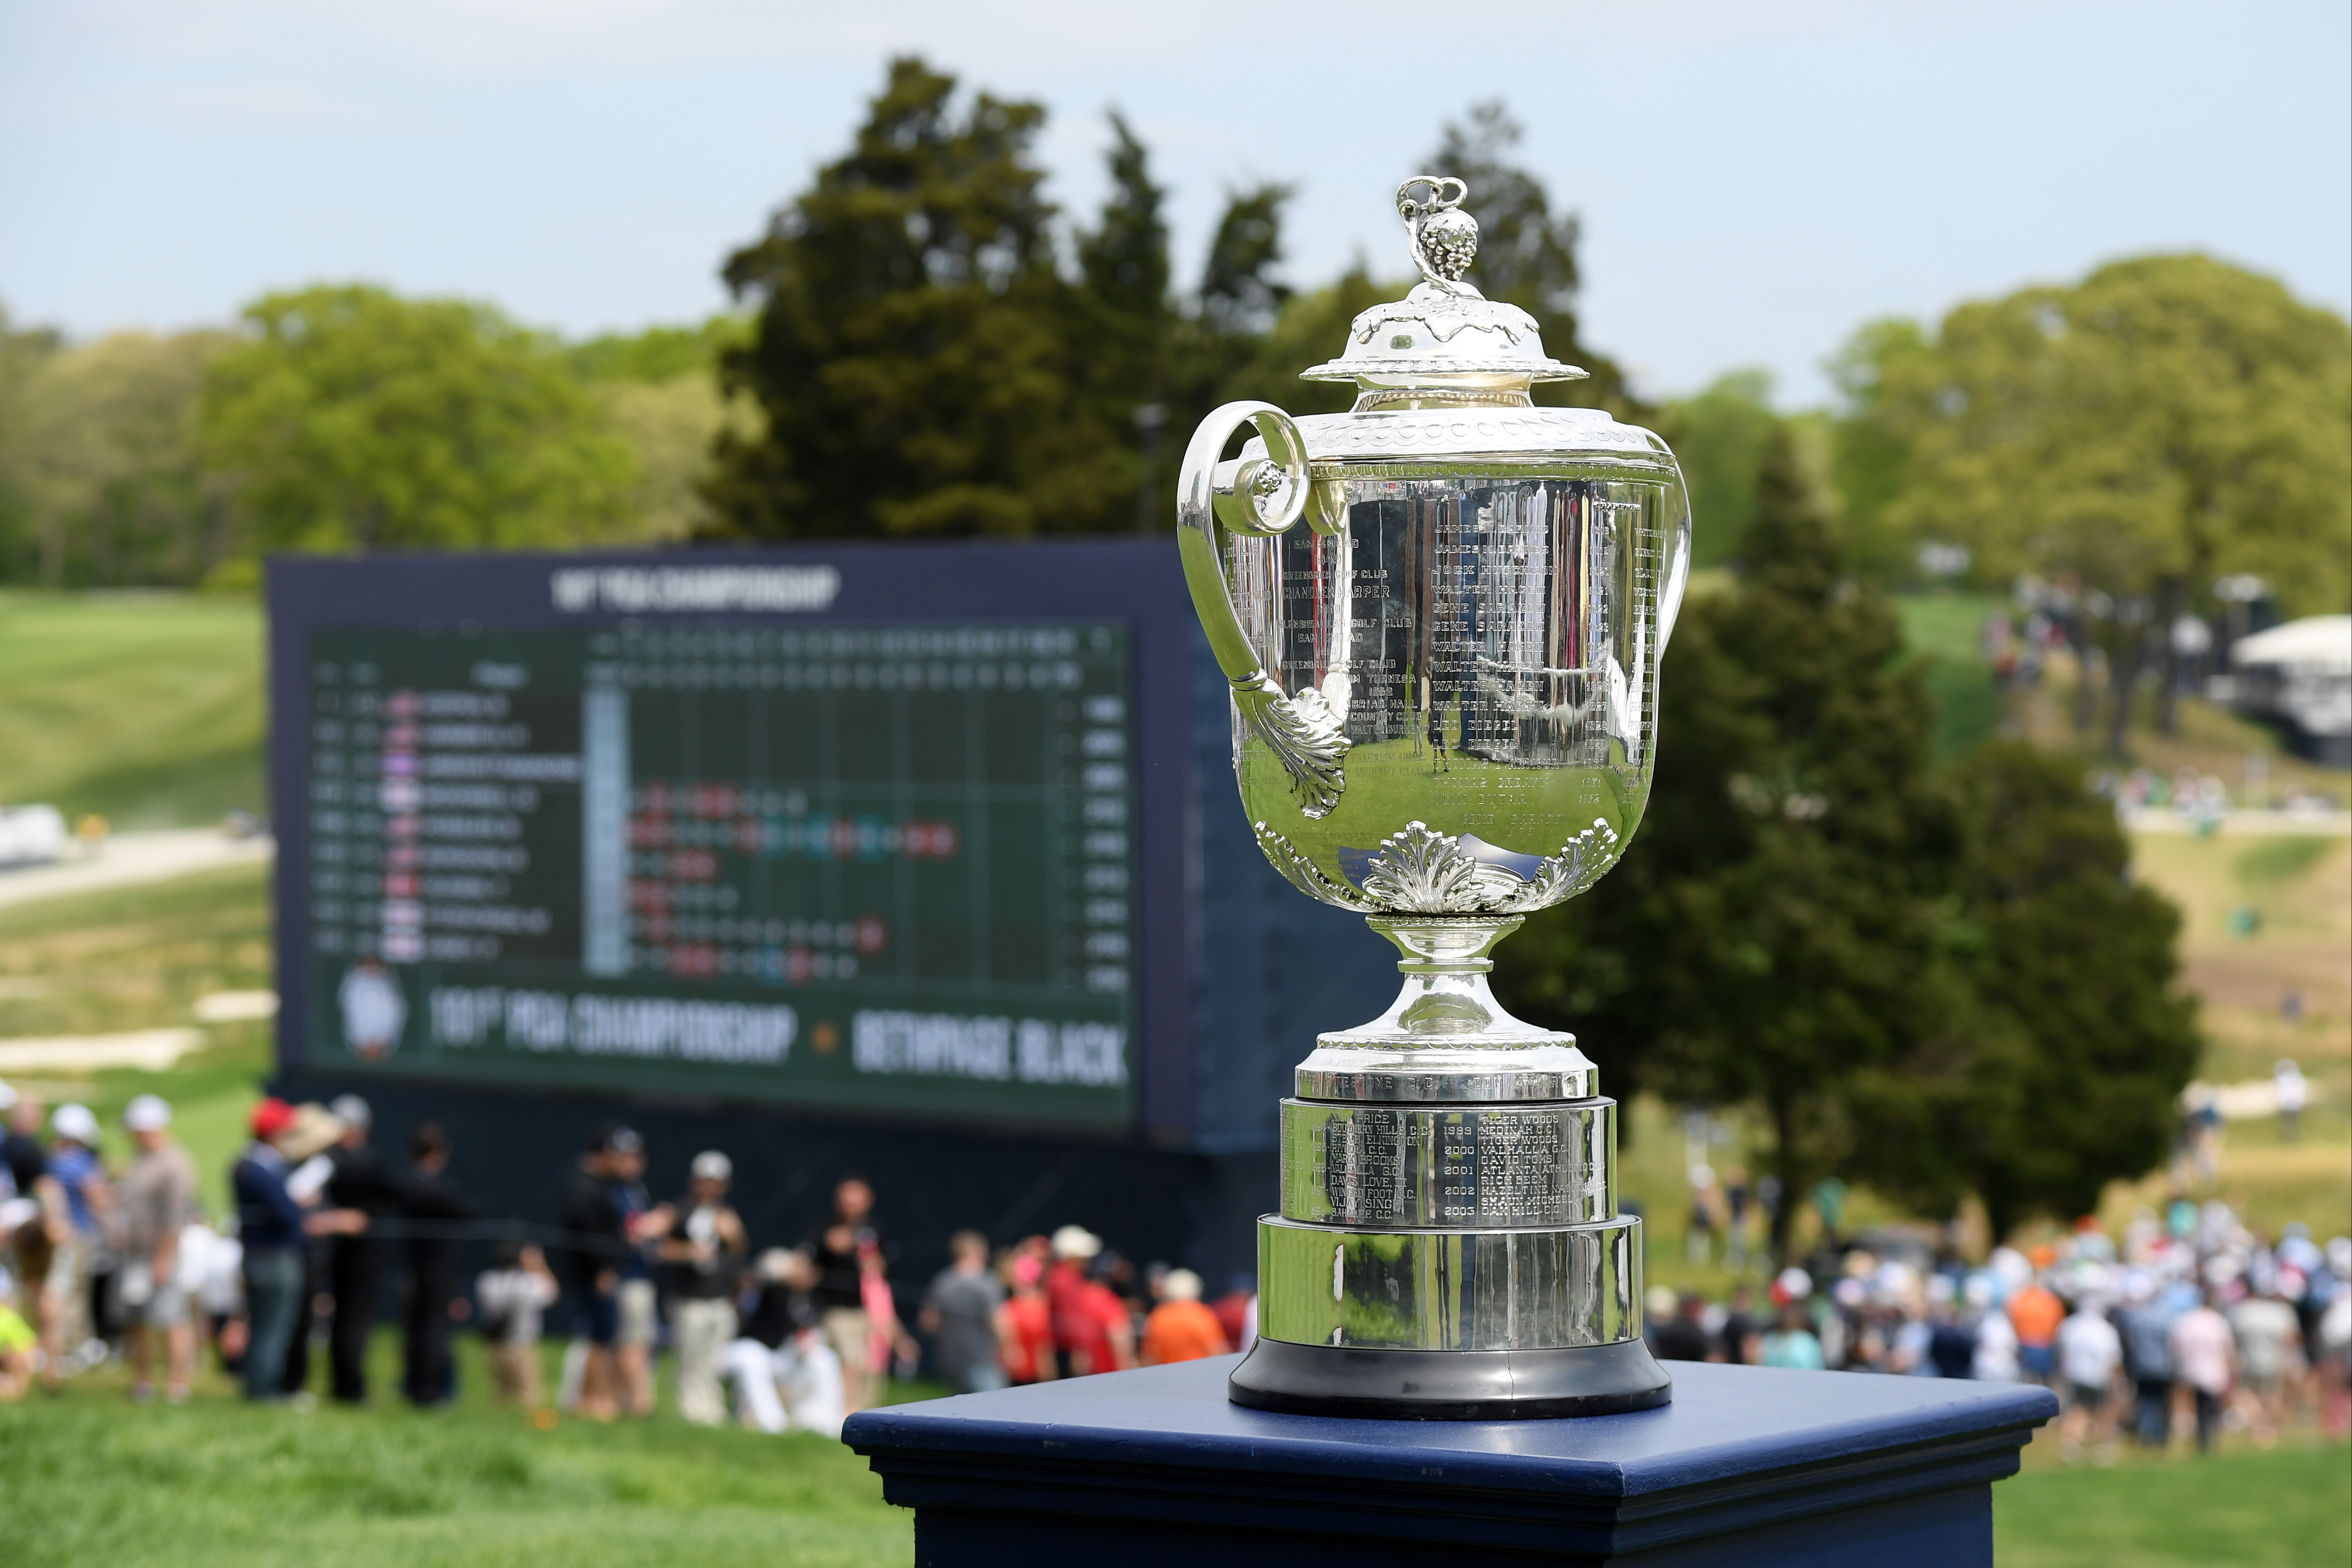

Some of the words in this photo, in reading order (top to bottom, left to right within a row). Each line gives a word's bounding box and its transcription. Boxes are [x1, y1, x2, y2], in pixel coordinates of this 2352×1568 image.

[1435, 525, 1478, 534] JAMES
[1501, 525, 1549, 534] BARNES
[1294, 539, 1315, 549] SAM
[1435, 545, 1479, 555] JAMES
[1501, 545, 1550, 555] BARNES
[1283, 570, 1331, 580] GREENBRIER
[1360, 569, 1388, 579] CLUB
[1432, 565, 1475, 575] JOCK
[1481, 565, 1558, 575] HUTCHISON
[650, 566, 840, 612] CHAMPIONSHIP
[1282, 586, 1335, 599] CHANDLER
[1338, 585, 1390, 598] HARPER
[1432, 585, 1493, 594] WALTER
[1499, 585, 1546, 595] HAGEN
[1432, 603, 1470, 613] GENE
[1478, 603, 1545, 613] SARAZEN
[1351, 618, 1377, 628] GOLF
[1383, 618, 1412, 628] CLUB
[1433, 621, 1468, 632] GENE
[1477, 621, 1545, 632] SARAZEN
[1297, 633, 1318, 643] SAM
[1432, 641, 1486, 652] WALTER
[1497, 641, 1544, 652] HAGEN
[1369, 659, 1396, 669] CLUB
[1433, 661, 1489, 672] WALTER
[1497, 661, 1544, 672] HAGEN
[1367, 674, 1417, 683] TURNESA
[1369, 687, 1393, 696] 1952
[1433, 681, 1489, 691] WALTER
[1495, 681, 1544, 692] HAGEN
[1352, 700, 1384, 710] BRIAR
[1389, 699, 1418, 709] HALL
[1433, 700, 1489, 711] WALTER
[1492, 700, 1545, 712] HAGEN
[1350, 712, 1393, 722] COUNTRY
[1396, 712, 1423, 721] CLUB
[1351, 724, 1385, 735] WALTER
[1433, 720, 1459, 730] LEO
[1467, 720, 1520, 730] DIEGEL
[1433, 739, 1460, 749] LEO
[1467, 739, 1519, 749] DIEGEL
[1351, 753, 1394, 763] FRANKLIN
[1434, 758, 1489, 769] THOMAS
[572, 994, 797, 1065] CHAMPIONSHIP
[852, 1009, 1011, 1080] BETHPAGE
[1018, 1019, 1128, 1086] BLACK
[1473, 1077, 1502, 1089] DON
[1357, 1114, 1390, 1124] PRICE
[1481, 1116, 1518, 1125] TIGER
[1521, 1116, 1559, 1124] WOODS
[1332, 1124, 1373, 1134] SOUTHERN
[1376, 1125, 1405, 1135] HILLS
[1444, 1127, 1472, 1135] 1999
[1480, 1126, 1533, 1135] MEDINAH
[1366, 1135, 1421, 1146] ELKINGTON
[1481, 1136, 1518, 1145] TIGER
[1523, 1135, 1558, 1144] WOODS
[1369, 1146, 1387, 1155] C.C.
[1444, 1146, 1474, 1155] 2000
[1481, 1146, 1549, 1155] VALHALLA
[1332, 1153, 1357, 1164] MARK
[1360, 1155, 1401, 1166] BROOKS
[1481, 1156, 1519, 1165] DAVID
[1524, 1155, 1552, 1164] TOMS
[1444, 1166, 1474, 1175] 2001
[1481, 1166, 1538, 1176] ATLANTA
[1331, 1175, 1358, 1185] DAVIS
[1481, 1176, 1512, 1185] RICH
[1516, 1176, 1547, 1184] BEEM
[1367, 1188, 1393, 1199] FOOT
[1445, 1187, 1475, 1195] 2002
[1481, 1186, 1548, 1195] HAZELTINE
[1331, 1197, 1360, 1207] VIJAY
[1365, 1199, 1400, 1210] SINGH
[1481, 1197, 1523, 1206] SHAUN
[1527, 1195, 1573, 1206] MICHEEL
[1376, 1210, 1393, 1219] C.C.
[1445, 1206, 1475, 1216] 2003
[1481, 1206, 1508, 1216] OAK
[1512, 1206, 1539, 1215] HILL
